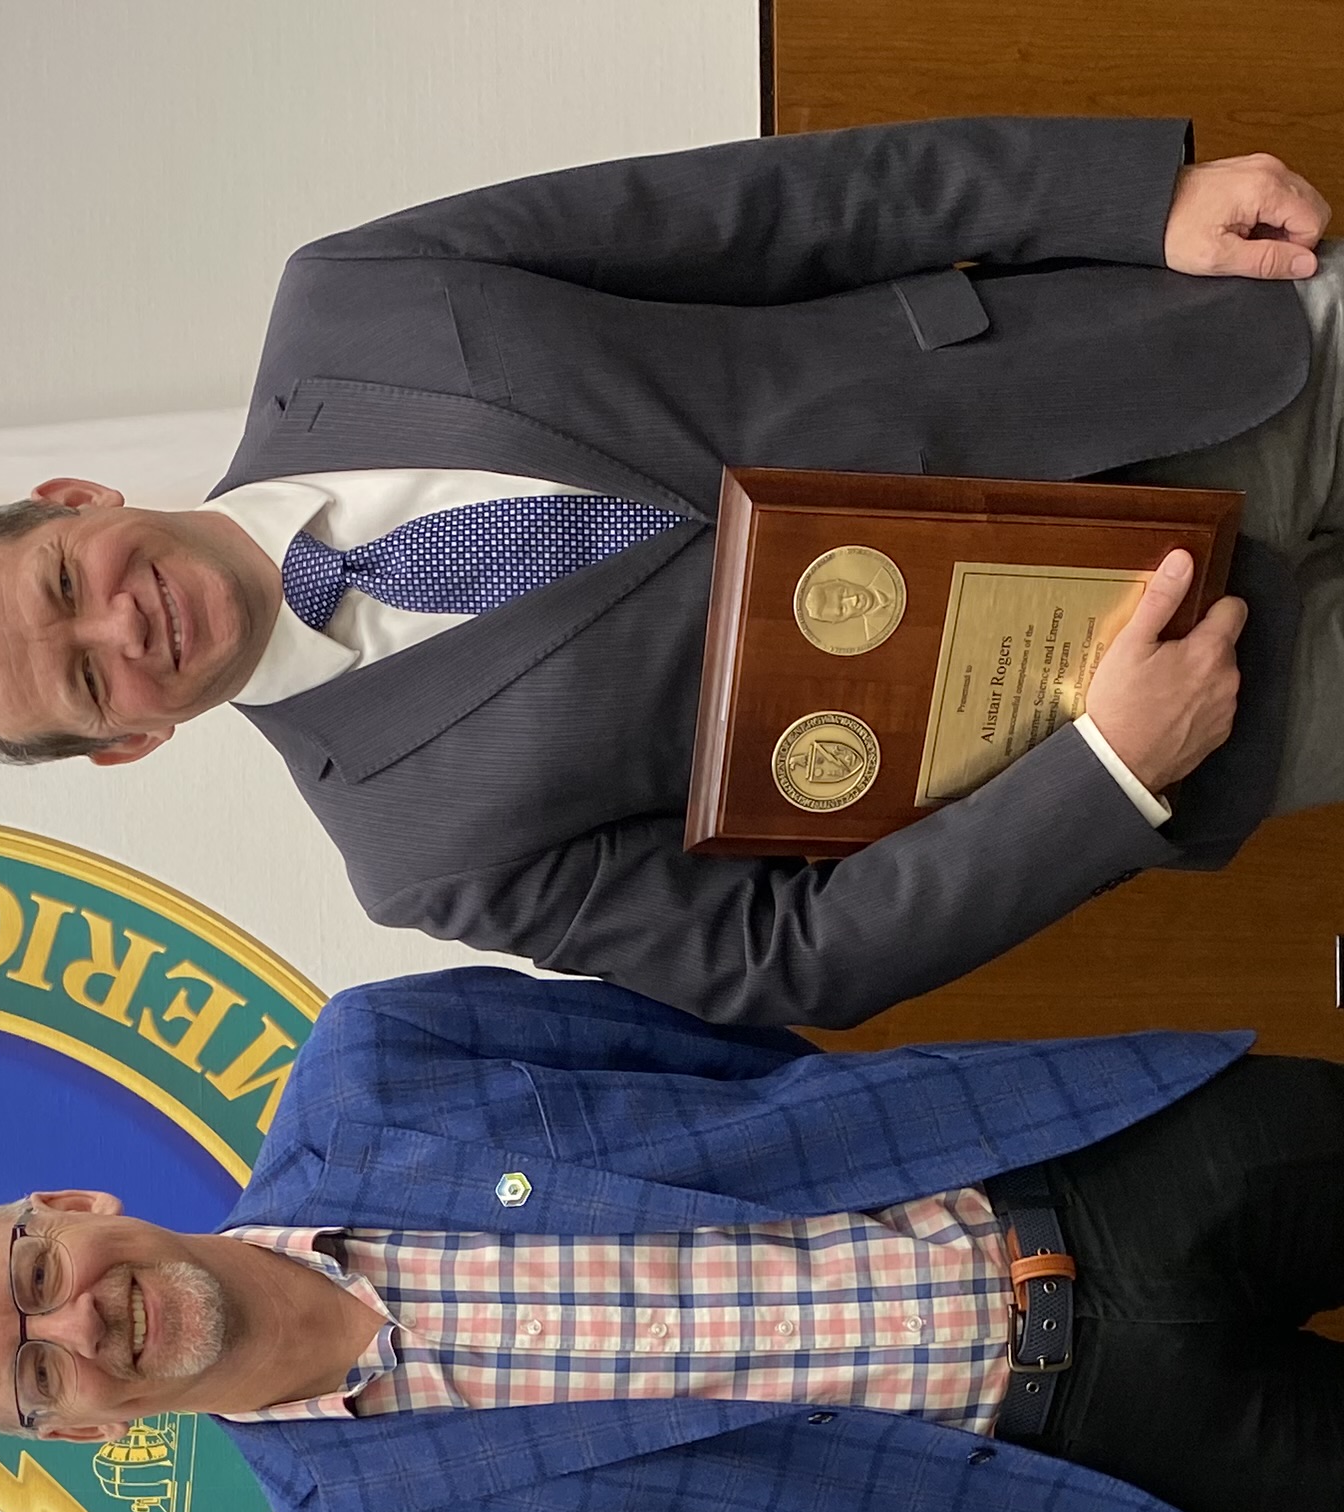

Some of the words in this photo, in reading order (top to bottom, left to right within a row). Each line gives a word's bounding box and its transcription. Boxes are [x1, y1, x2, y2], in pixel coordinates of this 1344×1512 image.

[1024, 624, 1034, 637] the
[1024, 638, 1031, 648] of
[1046, 606, 1064, 642] Energy
[990, 636, 1012, 686] Rogers
[1016, 650, 1030, 694] completion
[1043, 646, 1055, 664] and
[1053, 642, 1071, 684] Program
[1070, 692, 1082, 718] oratory
[1082, 617, 1096, 648] Council
[1091, 642, 1104, 669] Energy
[957, 675, 971, 713] Presented
[1033, 668, 1050, 706] Science
[980, 690, 1002, 744] Alistair
[1007, 696, 1021, 735] successful
[1045, 688, 1064, 736] eadership
